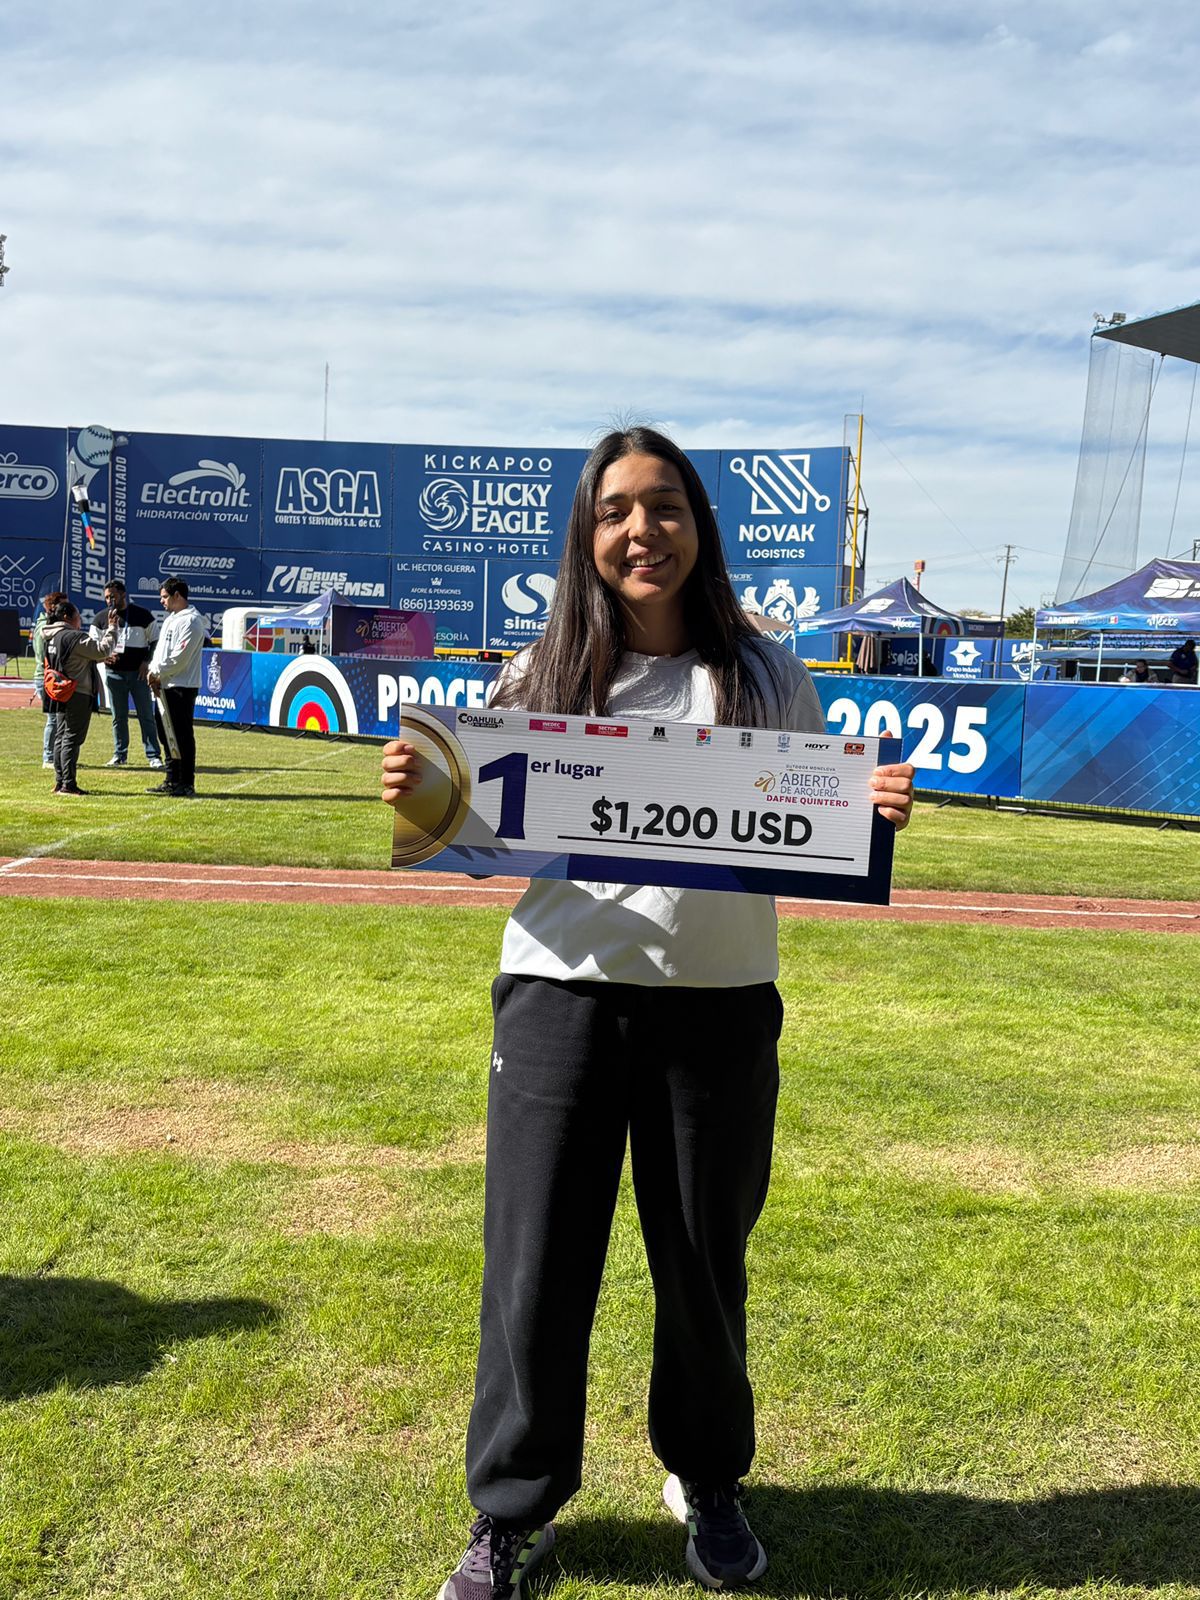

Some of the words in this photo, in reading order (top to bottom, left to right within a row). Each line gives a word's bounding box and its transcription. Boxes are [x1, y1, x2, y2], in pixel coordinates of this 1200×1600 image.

[424, 453, 553, 472] KICKAPOO
[115, 455, 128, 524] RESULTADO
[140, 482, 250, 508] Electrolit
[275, 467, 382, 518] ASGA
[472, 479, 552, 508] LUCKY
[213, 512, 249, 523] TOTAL!
[275, 515, 300, 525] CORTES
[302, 516, 308, 525] Y
[308, 517, 343, 527] SERVICIOS
[358, 519, 368, 528] de
[471, 508, 550, 535] EAGLE
[115, 527, 126, 543] ES
[738, 523, 816, 543] NOVAK
[72, 519, 83, 593] IMPULSANDO
[422, 541, 485, 554] CASINO
[498, 543, 549, 555] HOTEL
[746, 548, 805, 559] LOGISTICS
[167, 554, 236, 570] TURISTICOS
[397, 563, 410, 571] LIC.
[412, 563, 443, 573] HECTOR
[444, 564, 476, 574] GUERRA
[295, 580, 385, 597] RESEMSA
[399, 597, 474, 612] (866)1393639
[194, 695, 236, 710] MONCLOVA
[457, 712, 504, 725] COAHUILA
[827, 697, 989, 774] 2025
[555, 758, 604, 780] lugar
[780, 773, 840, 789] ABIERTO
[780, 786, 792, 795] DE
[766, 794, 798, 804] DAFNE
[800, 797, 849, 808] QUINTERO
[589, 795, 719, 840] $1,200
[731, 809, 813, 846] USD
